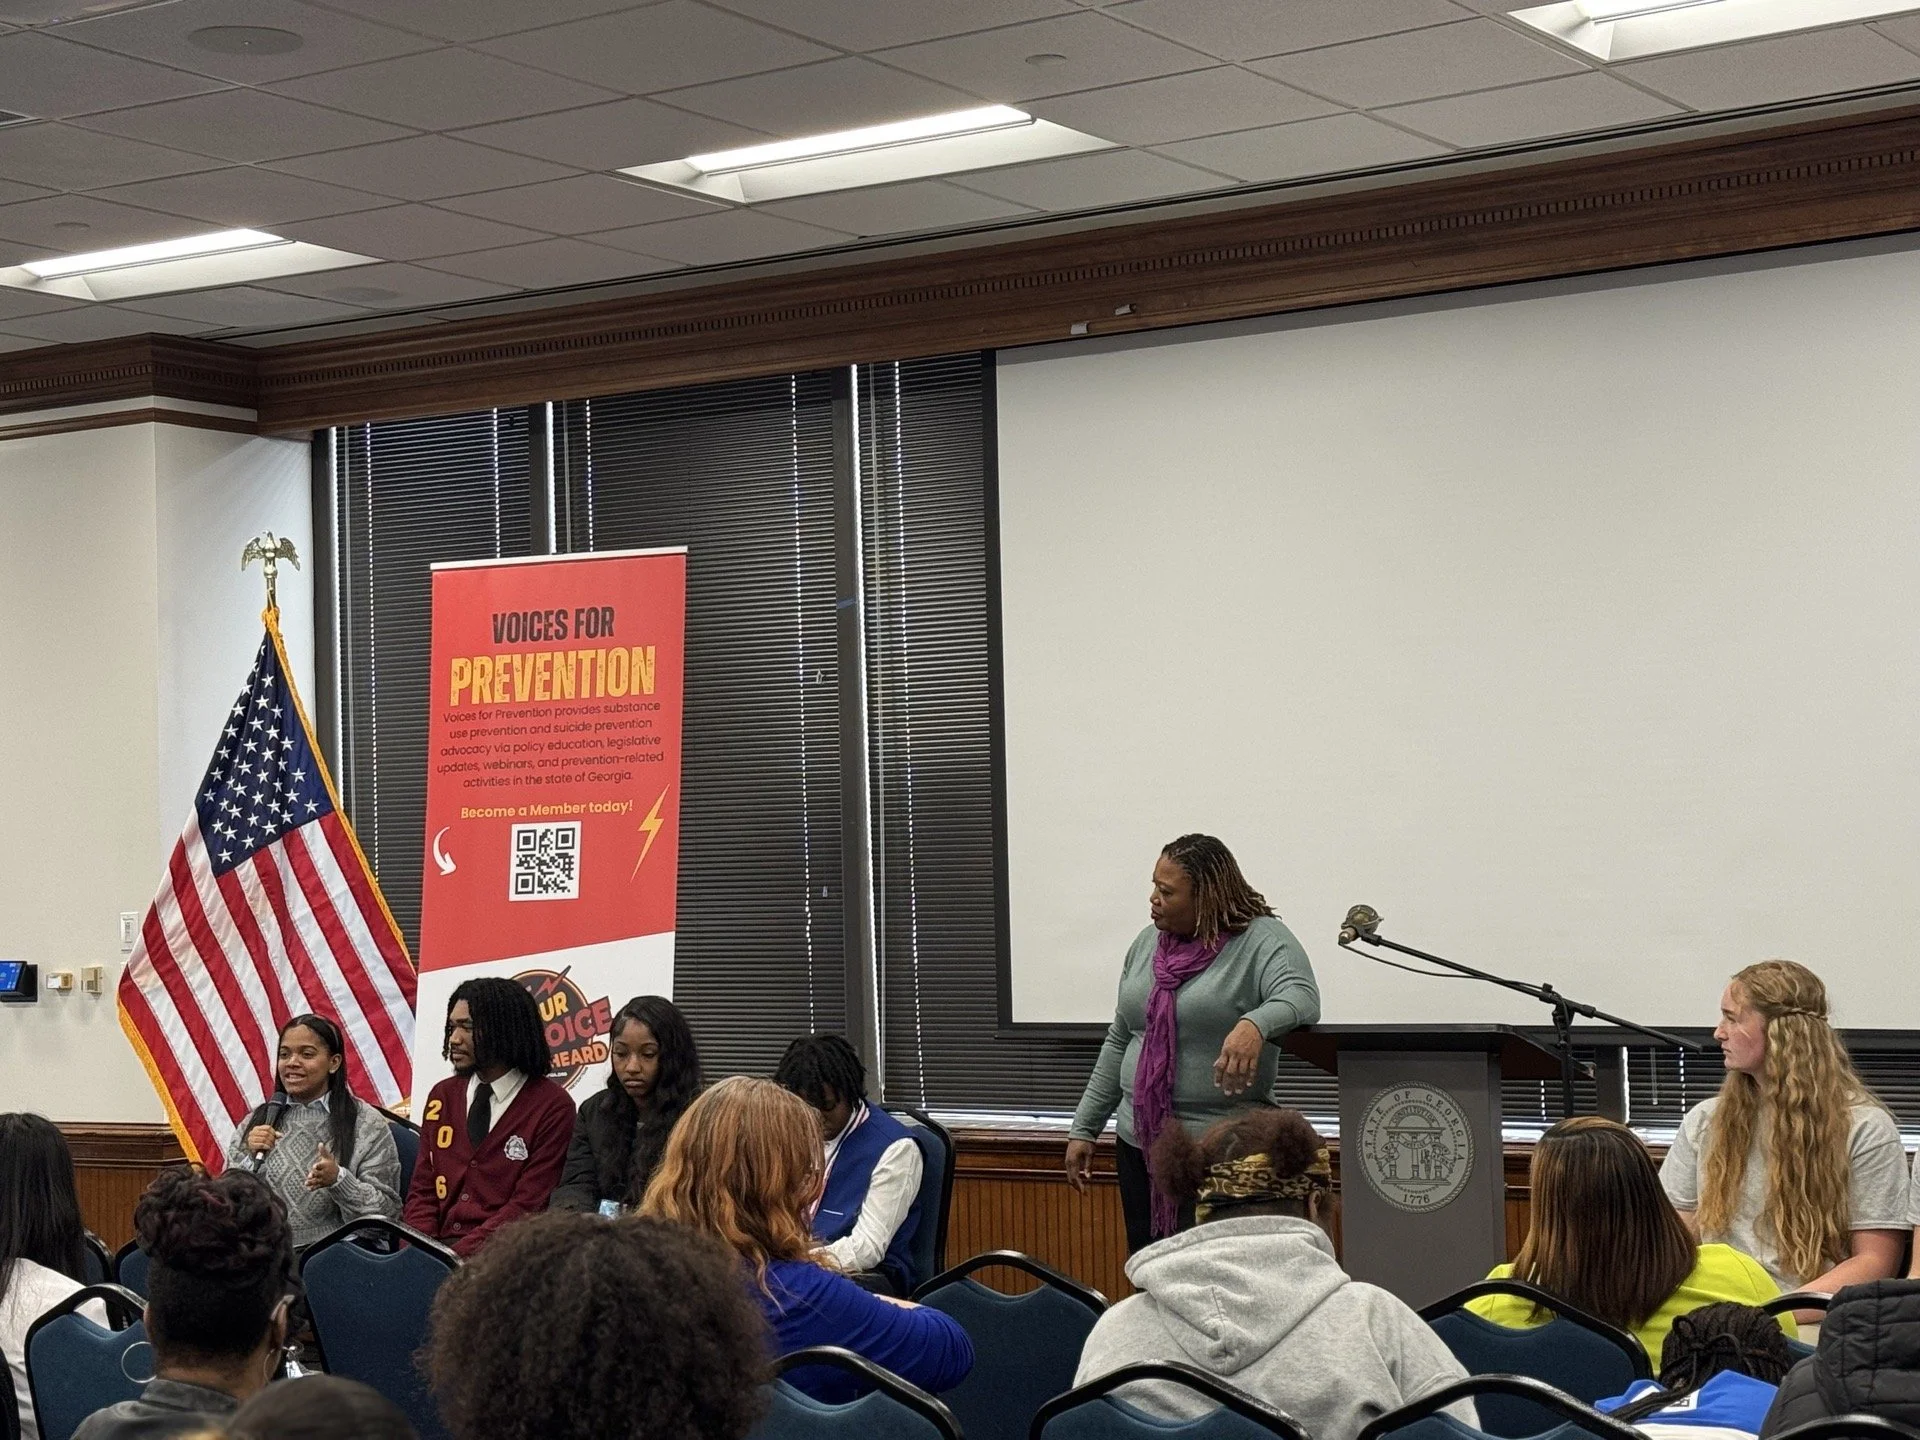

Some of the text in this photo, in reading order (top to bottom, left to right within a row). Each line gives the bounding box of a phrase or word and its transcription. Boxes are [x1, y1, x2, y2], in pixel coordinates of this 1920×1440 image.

[492, 606, 615, 644] VOICES FOR
[450, 646, 656, 707] PREVENTION
[443, 702, 661, 722] Voices for Prevention provides substance
[449, 718, 652, 740] use prevention and suicide prevention
[440, 735, 661, 756] advocacy via policy education, legislative
[436, 751, 664, 776] updates, webinars, and prevention-related
[463, 776, 510, 788] activities
[513, 775, 523, 786] in
[525, 775, 543, 785] the
[545, 773, 572, 784] state
[574, 771, 585, 783] of
[461, 799, 633, 819] Become a Member today!
[539, 991, 569, 1022] UR
[544, 997, 612, 1047] OICE
[1365, 1090, 1466, 1161] STATE OF GEORGIA
[1402, 1193, 1431, 1205] 1776
